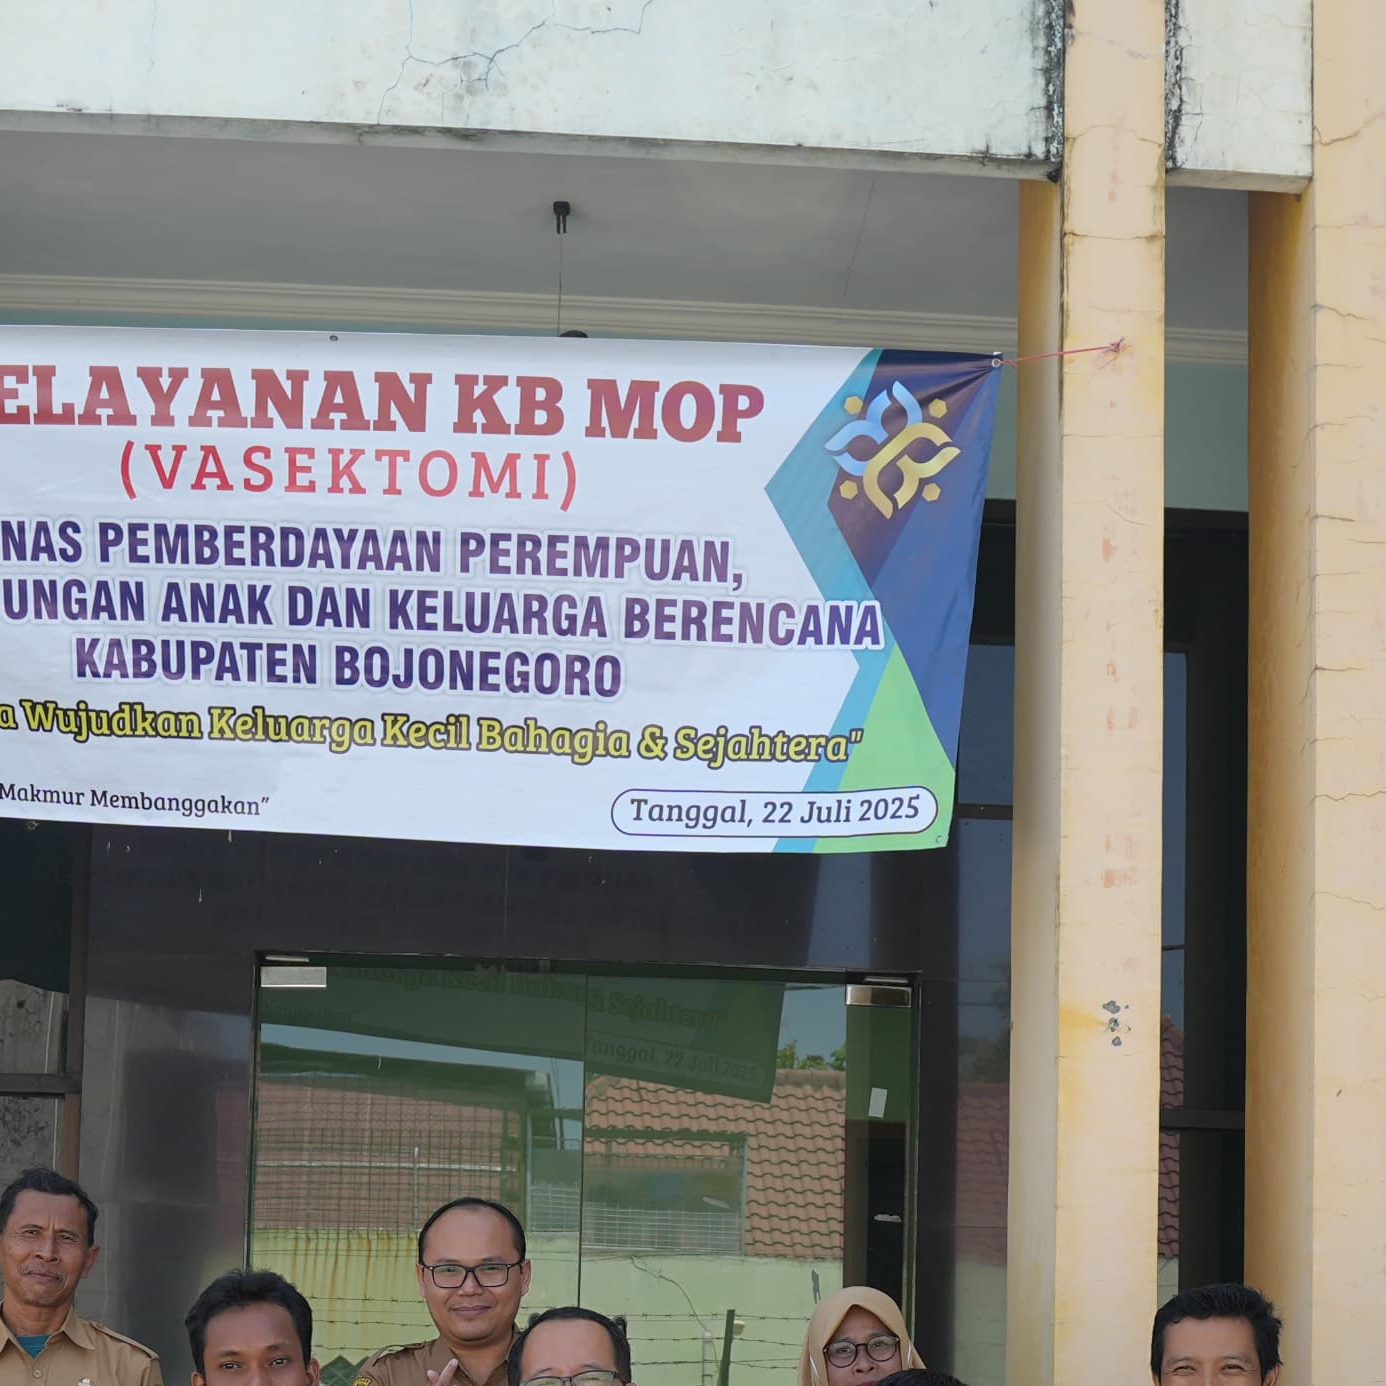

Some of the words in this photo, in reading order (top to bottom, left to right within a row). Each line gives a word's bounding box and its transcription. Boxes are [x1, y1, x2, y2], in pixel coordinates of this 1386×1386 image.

[452, 373, 566, 438] KB
[585, 378, 765, 444] MOP
[119, 439, 577, 513] (VASEKTOMI)
[98, 522, 441, 573] PEMBERDAYAAN
[460, 531, 745, 592] PEREMPUAN,
[161, 582, 273, 627] ANAK
[289, 586, 371, 629] DAN
[389, 590, 608, 639] KELUARGA
[624, 602, 882, 647] BERENCANA
[75, 637, 316, 685] KABUPATEN
[335, 646, 622, 698] BOJONEGORO
[21, 699, 202, 742] Wujudkan
[208, 706, 374, 754] Keluarga
[382, 714, 470, 751] Kecil
[478, 718, 631, 765] Bahagia
[637, 728, 667, 760] &
[673, 727, 864, 769] Sejahtera"
[630, 797, 754, 830] Tanggal,
[761, 801, 793, 823] 22
[798, 797, 852, 828] Juli
[859, 793, 920, 822] 2025
